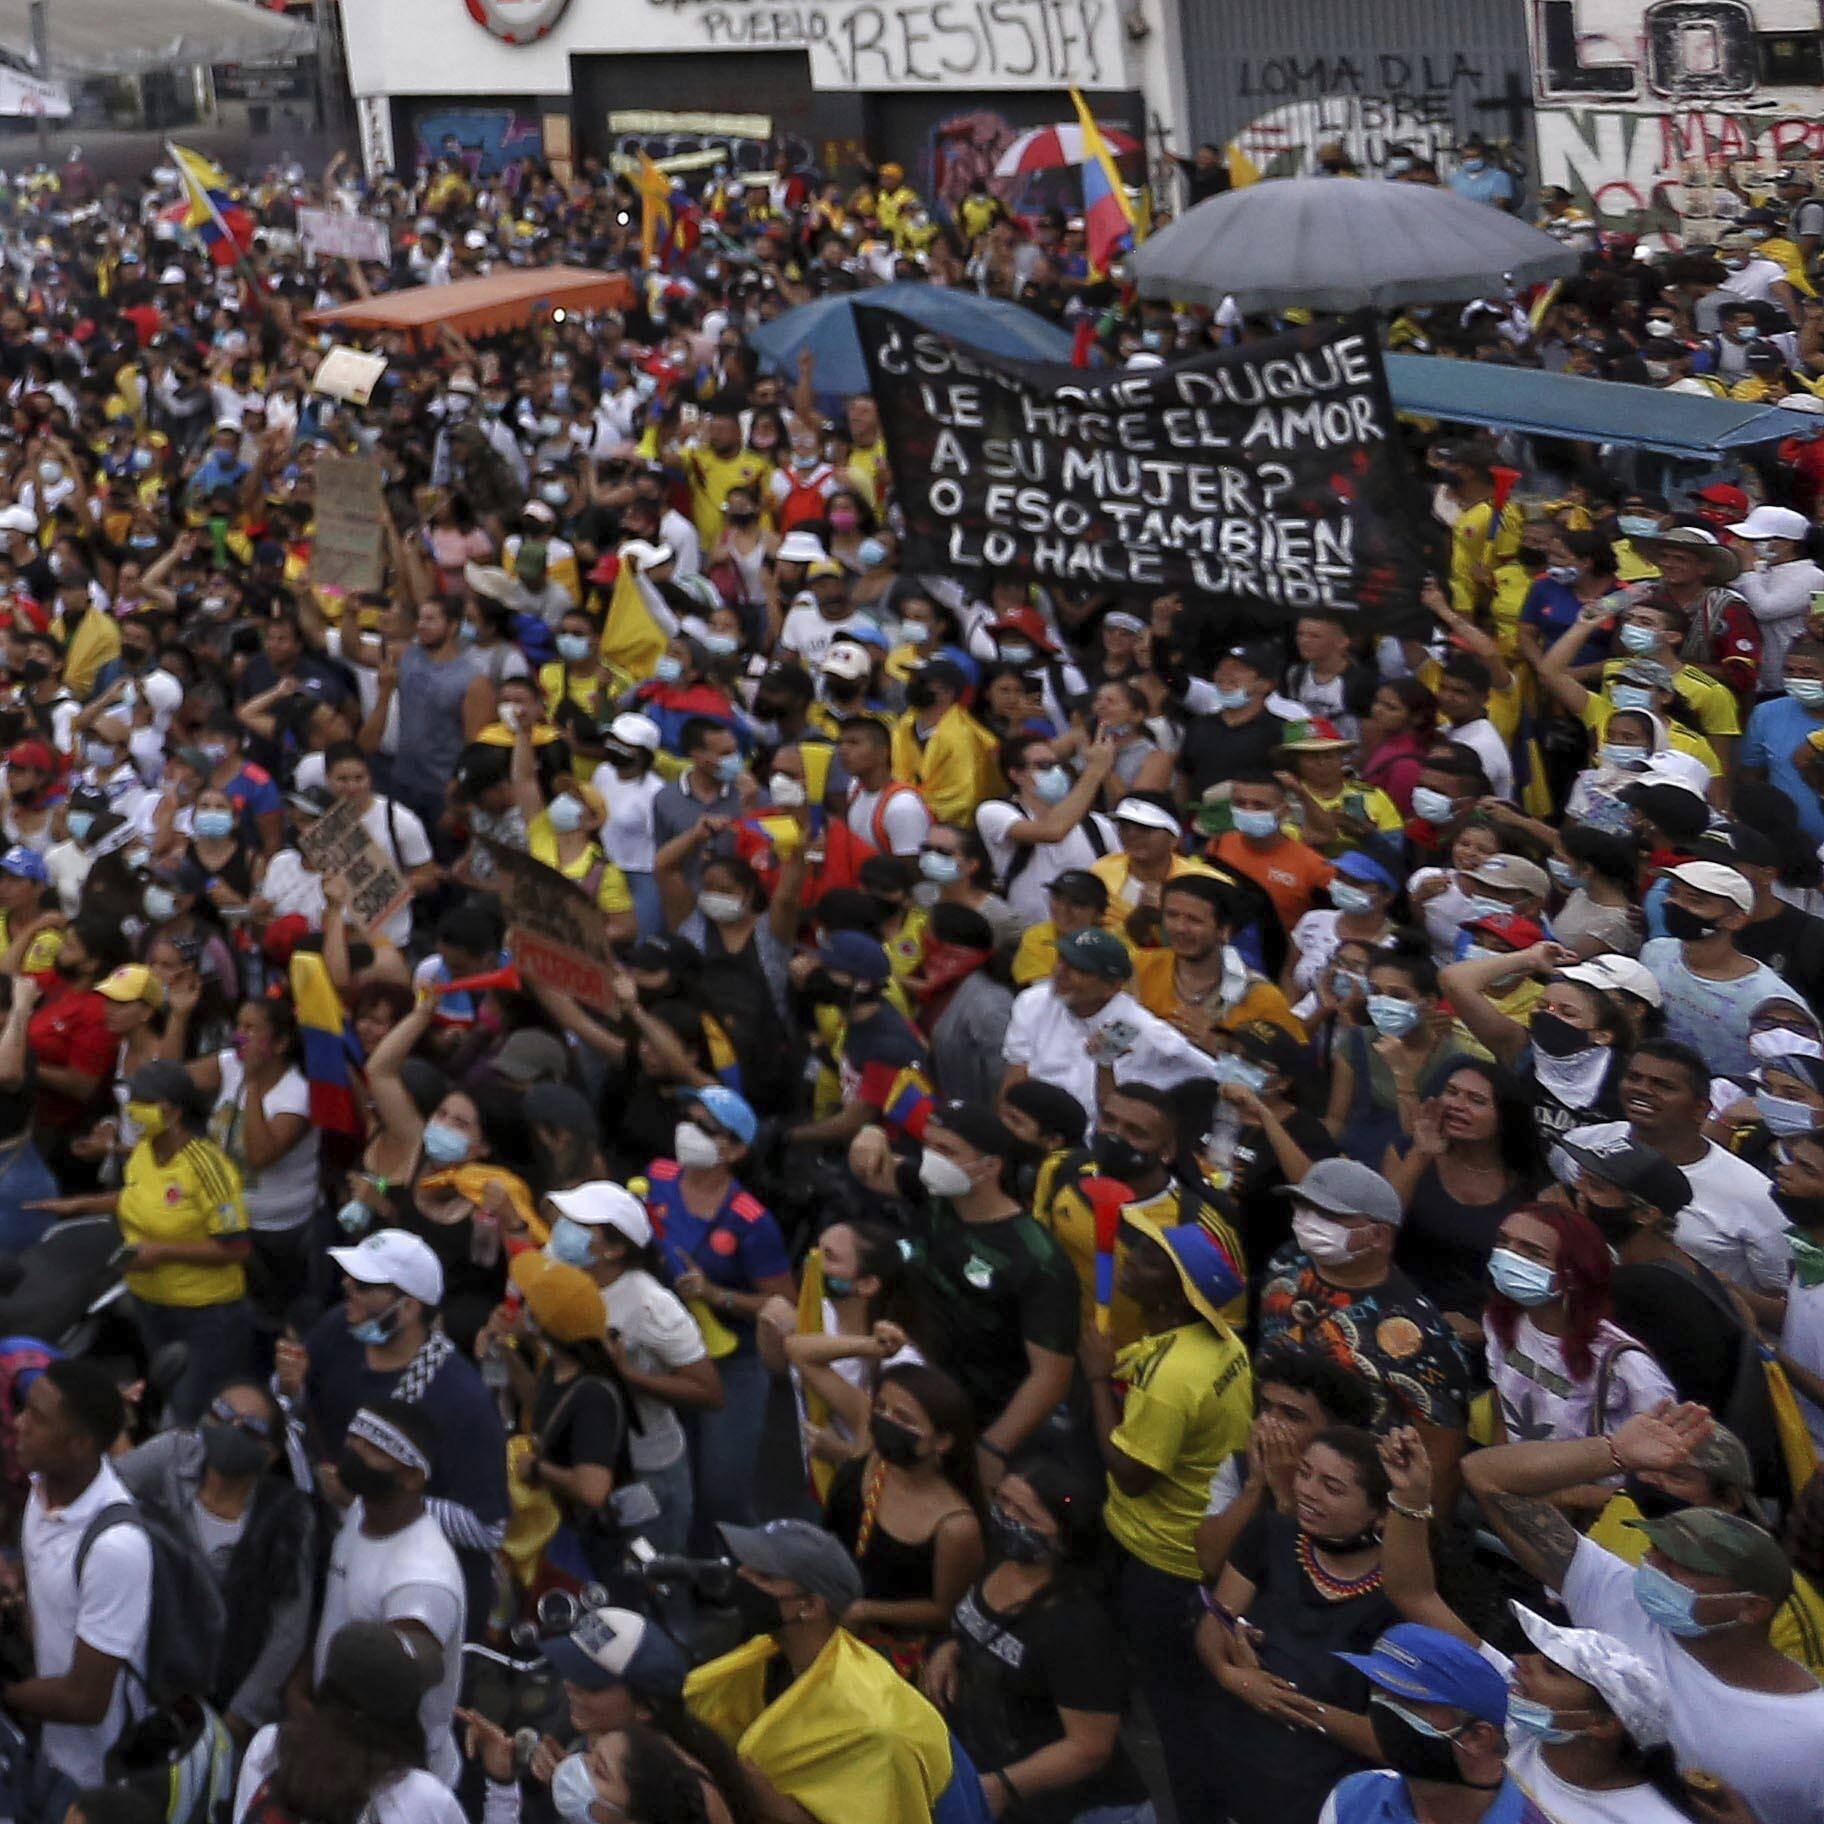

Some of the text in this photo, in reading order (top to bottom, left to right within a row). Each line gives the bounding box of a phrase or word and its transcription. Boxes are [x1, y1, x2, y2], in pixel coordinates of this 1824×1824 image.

[1175, 335, 1373, 406] DUQUE
[920, 383, 984, 428] LE
[1162, 408, 1231, 448] EL
[1241, 394, 1386, 450] AMOR
[928, 477, 964, 517] O
[984, 484, 1091, 536] ESO
[930, 428, 1296, 516] A SU MUJER?
[948, 522, 1017, 566] LO
[1187, 549, 1360, 611] URIBE
